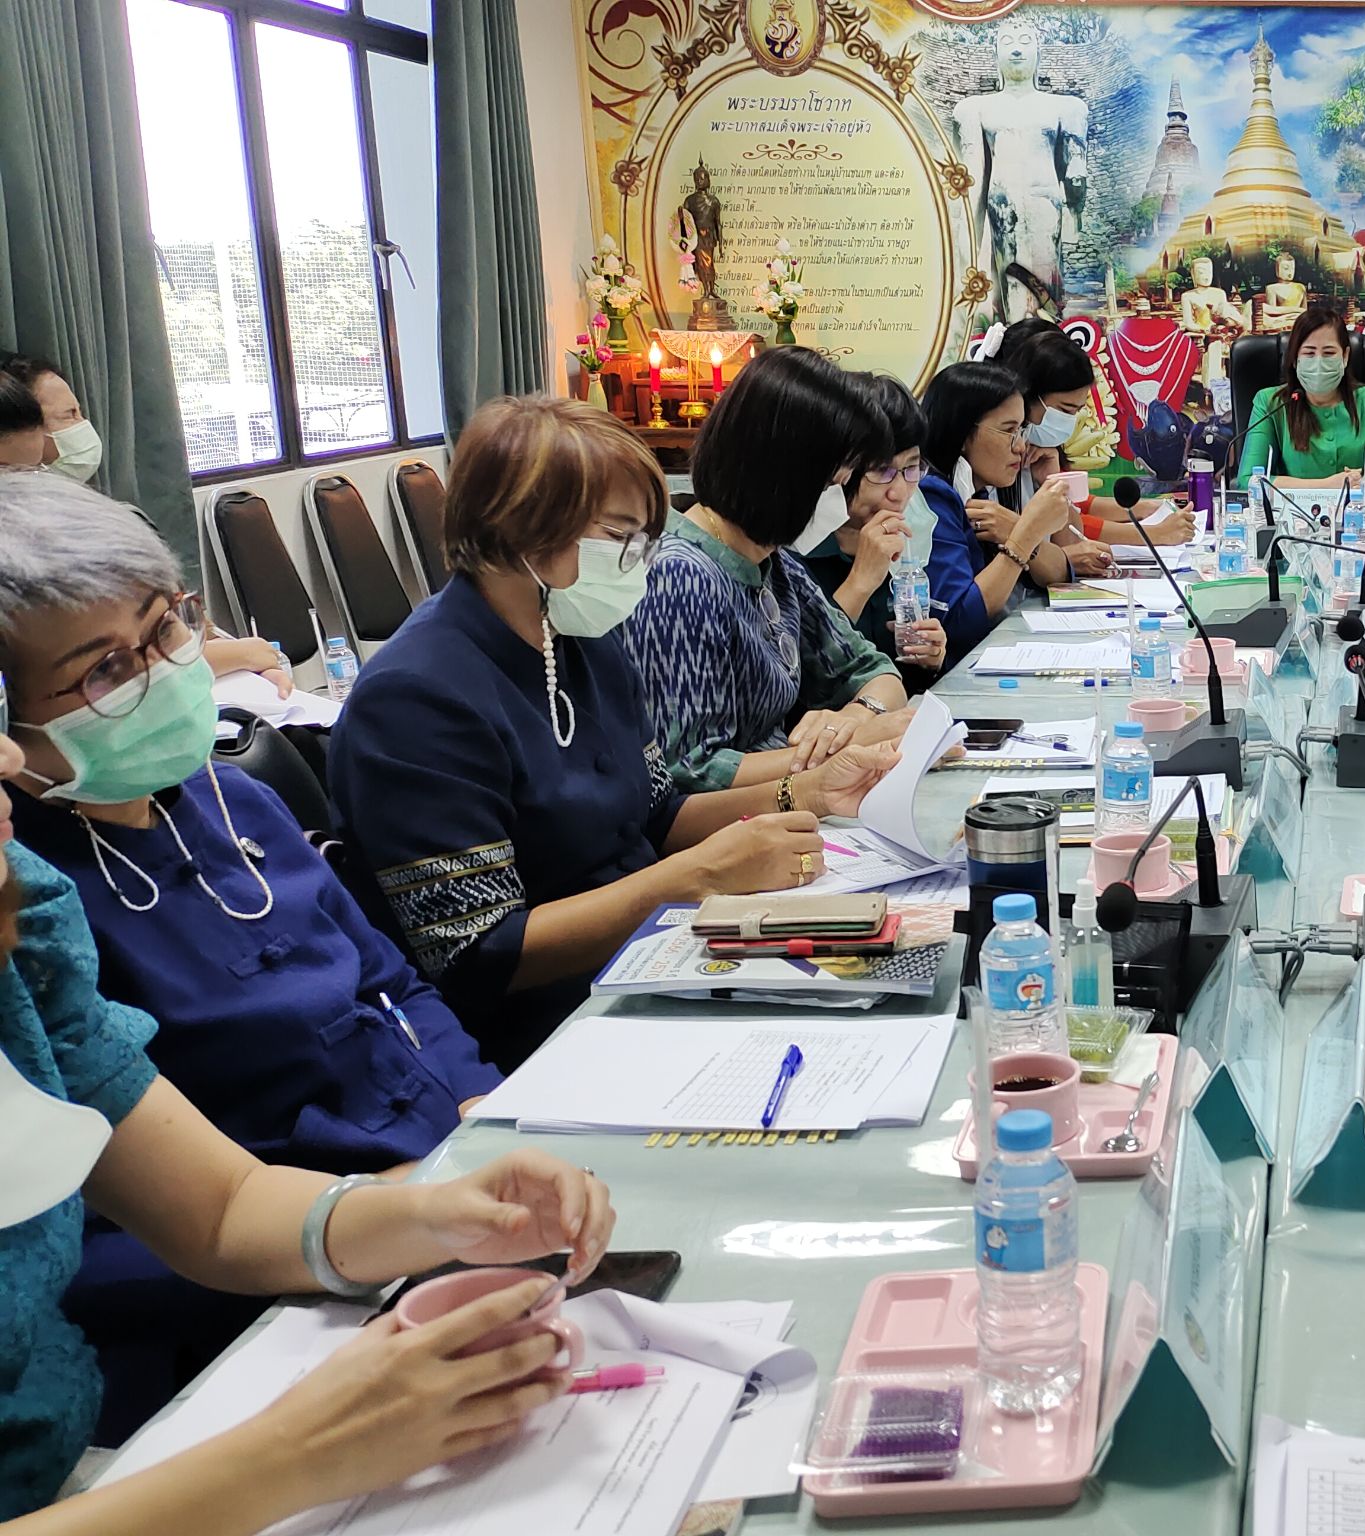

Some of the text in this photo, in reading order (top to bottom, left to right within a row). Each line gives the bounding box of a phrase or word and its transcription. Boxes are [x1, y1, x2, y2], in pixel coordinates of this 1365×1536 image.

[727, 90, 852, 112] พระบรมราโชวาท
[710, 118, 872, 137] พระบาทสมเด็จพระเจ้าอยู่หัว
